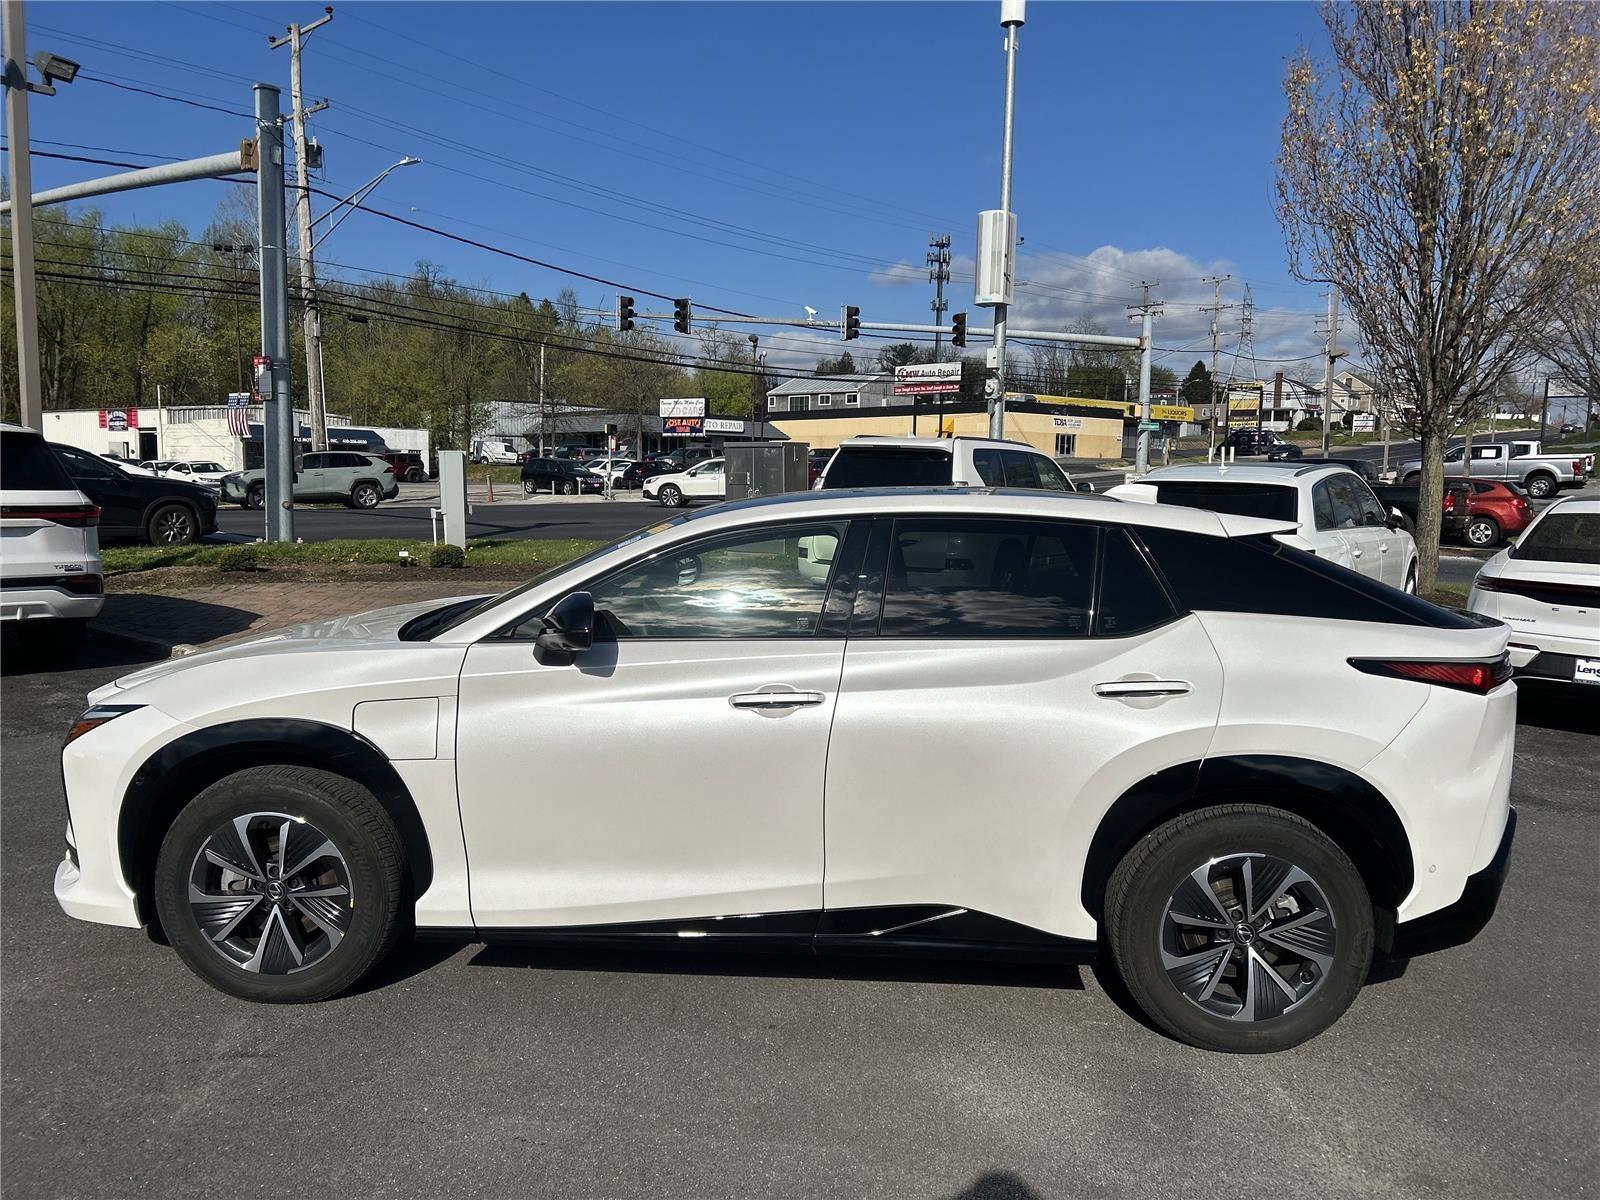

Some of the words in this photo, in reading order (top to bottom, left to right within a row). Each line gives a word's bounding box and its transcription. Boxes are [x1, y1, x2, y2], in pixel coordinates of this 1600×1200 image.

[938, 368, 960, 379] Repair
[666, 418, 682, 428] JOSE
[682, 418, 701, 427] AUTO
[720, 421, 743, 430] REPAIR
